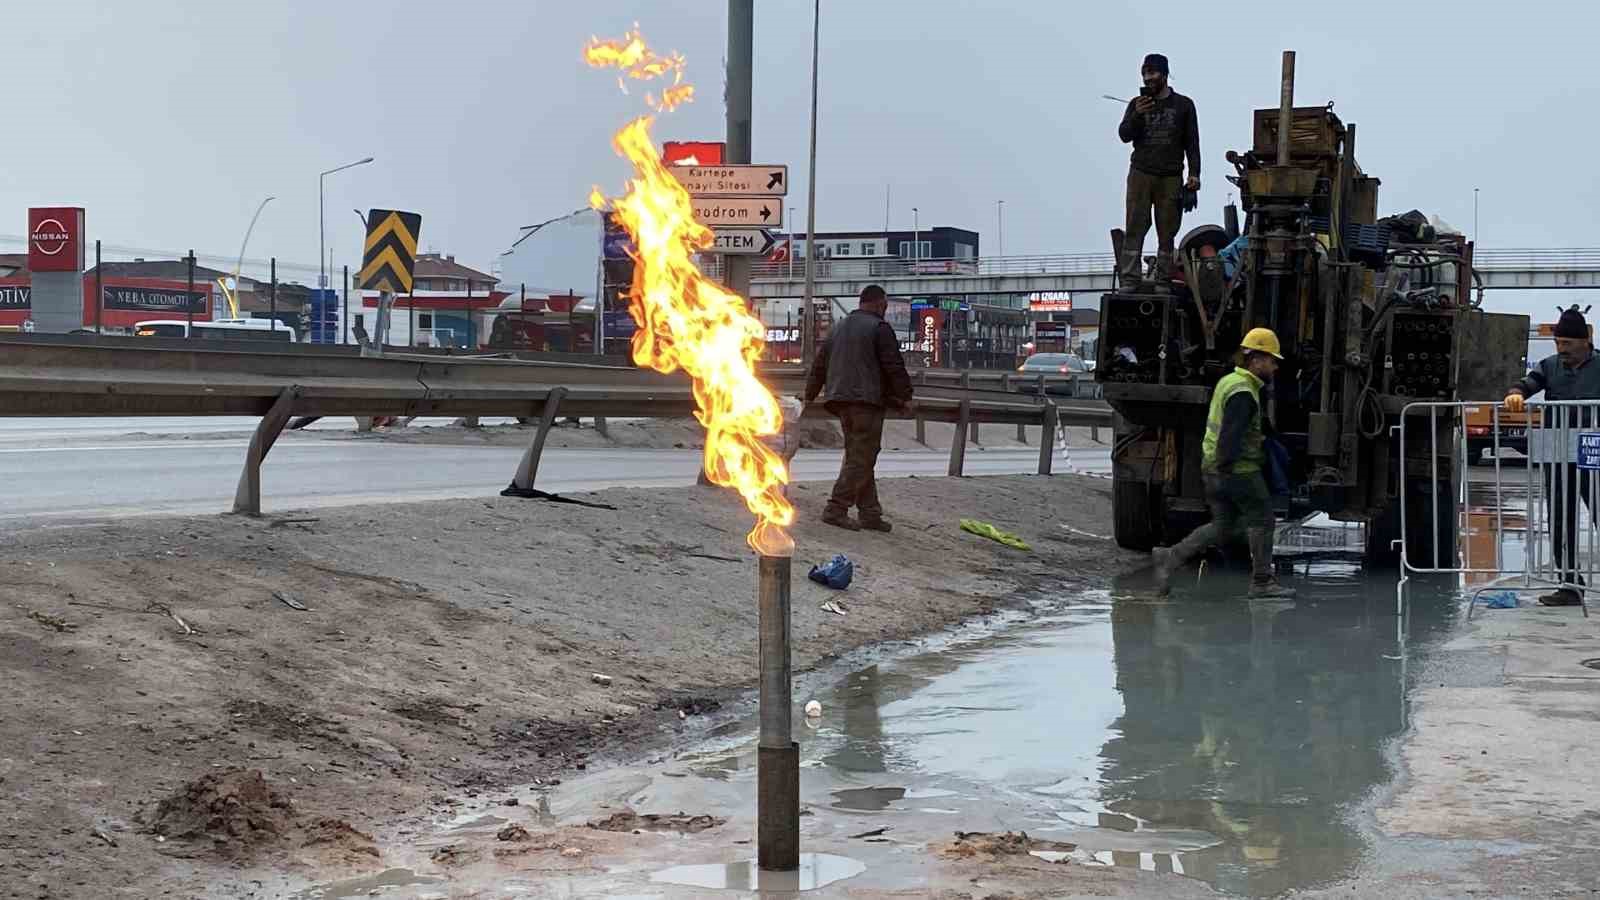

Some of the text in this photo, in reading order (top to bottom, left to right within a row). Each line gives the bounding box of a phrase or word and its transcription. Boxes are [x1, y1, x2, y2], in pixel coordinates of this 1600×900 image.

[689, 168, 735, 178] Kartepe
[718, 181, 751, 190] Sitesi
[32, 233, 69, 241] NISSAN
[766, 329, 800, 342] EBAP
